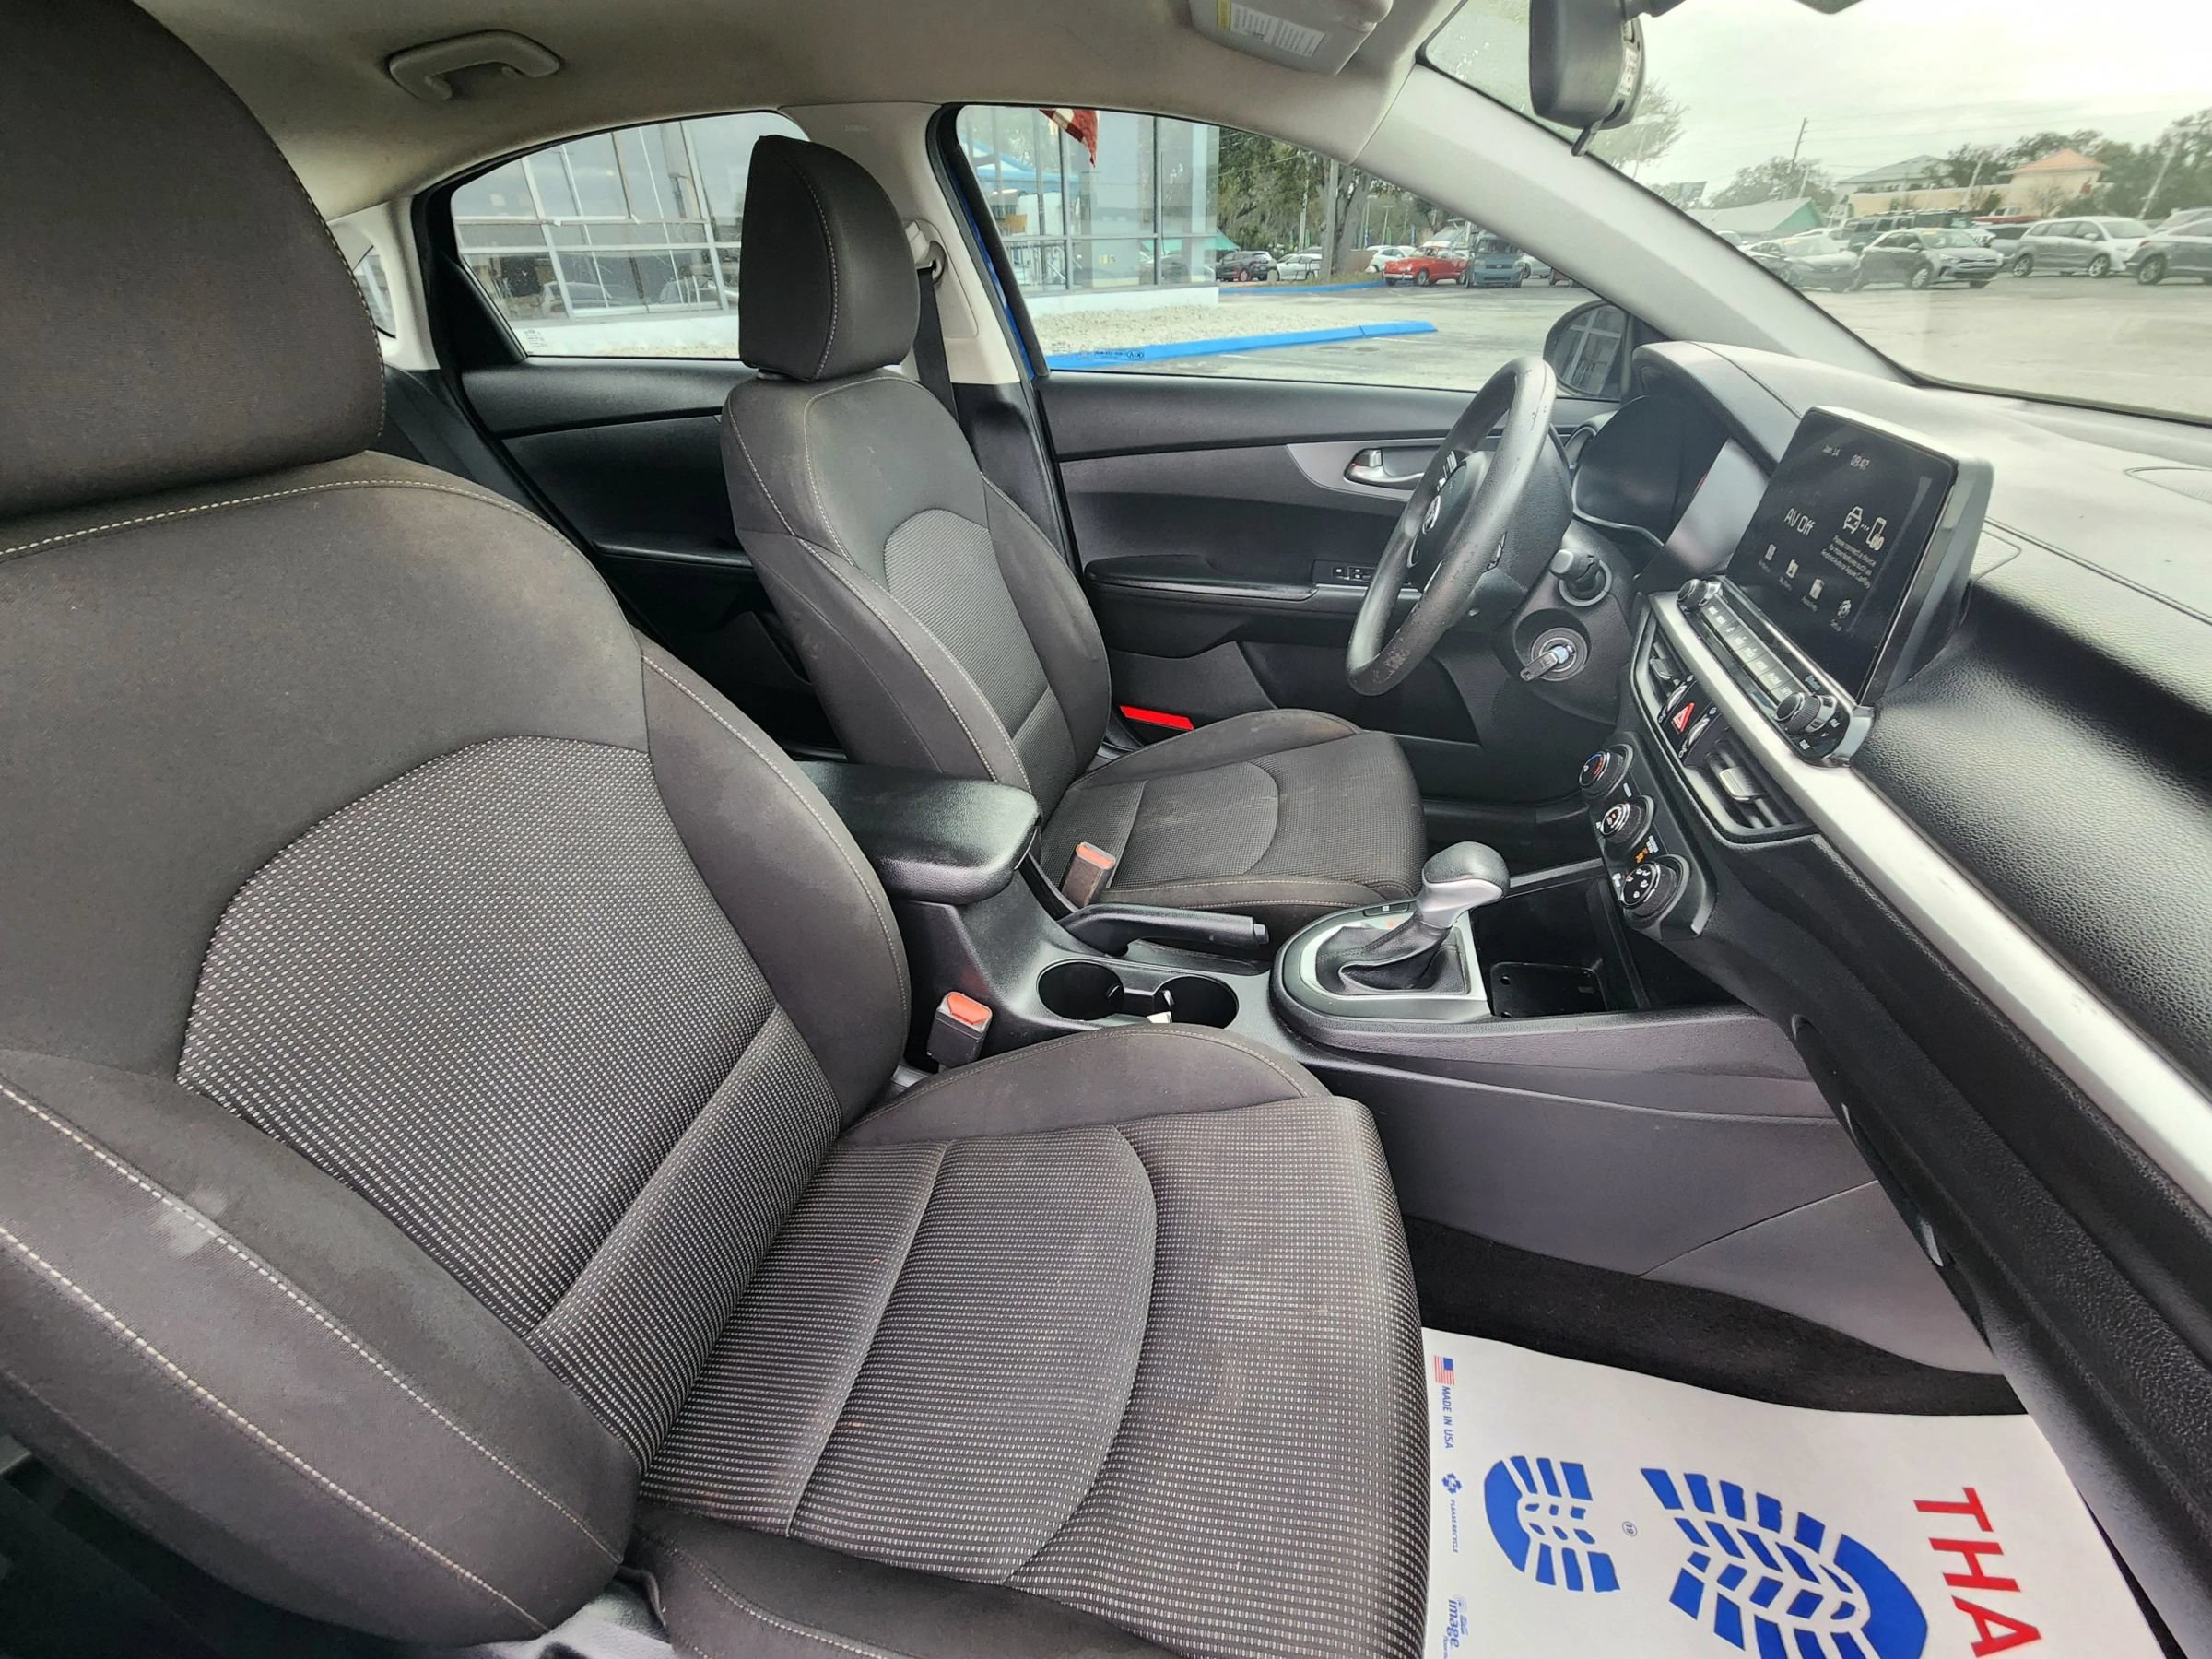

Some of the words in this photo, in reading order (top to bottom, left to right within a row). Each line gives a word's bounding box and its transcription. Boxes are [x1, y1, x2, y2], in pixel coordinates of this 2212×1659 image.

[1783, 508, 1801, 527] AV
[1797, 515, 1816, 536] Off
[1441, 1385, 1453, 1412] MADE
[1443, 1415, 1453, 1426] IN
[1444, 1429, 1454, 1449] USA
[1913, 1487, 2041, 1658] THA
[1447, 1599, 1461, 1648] image
